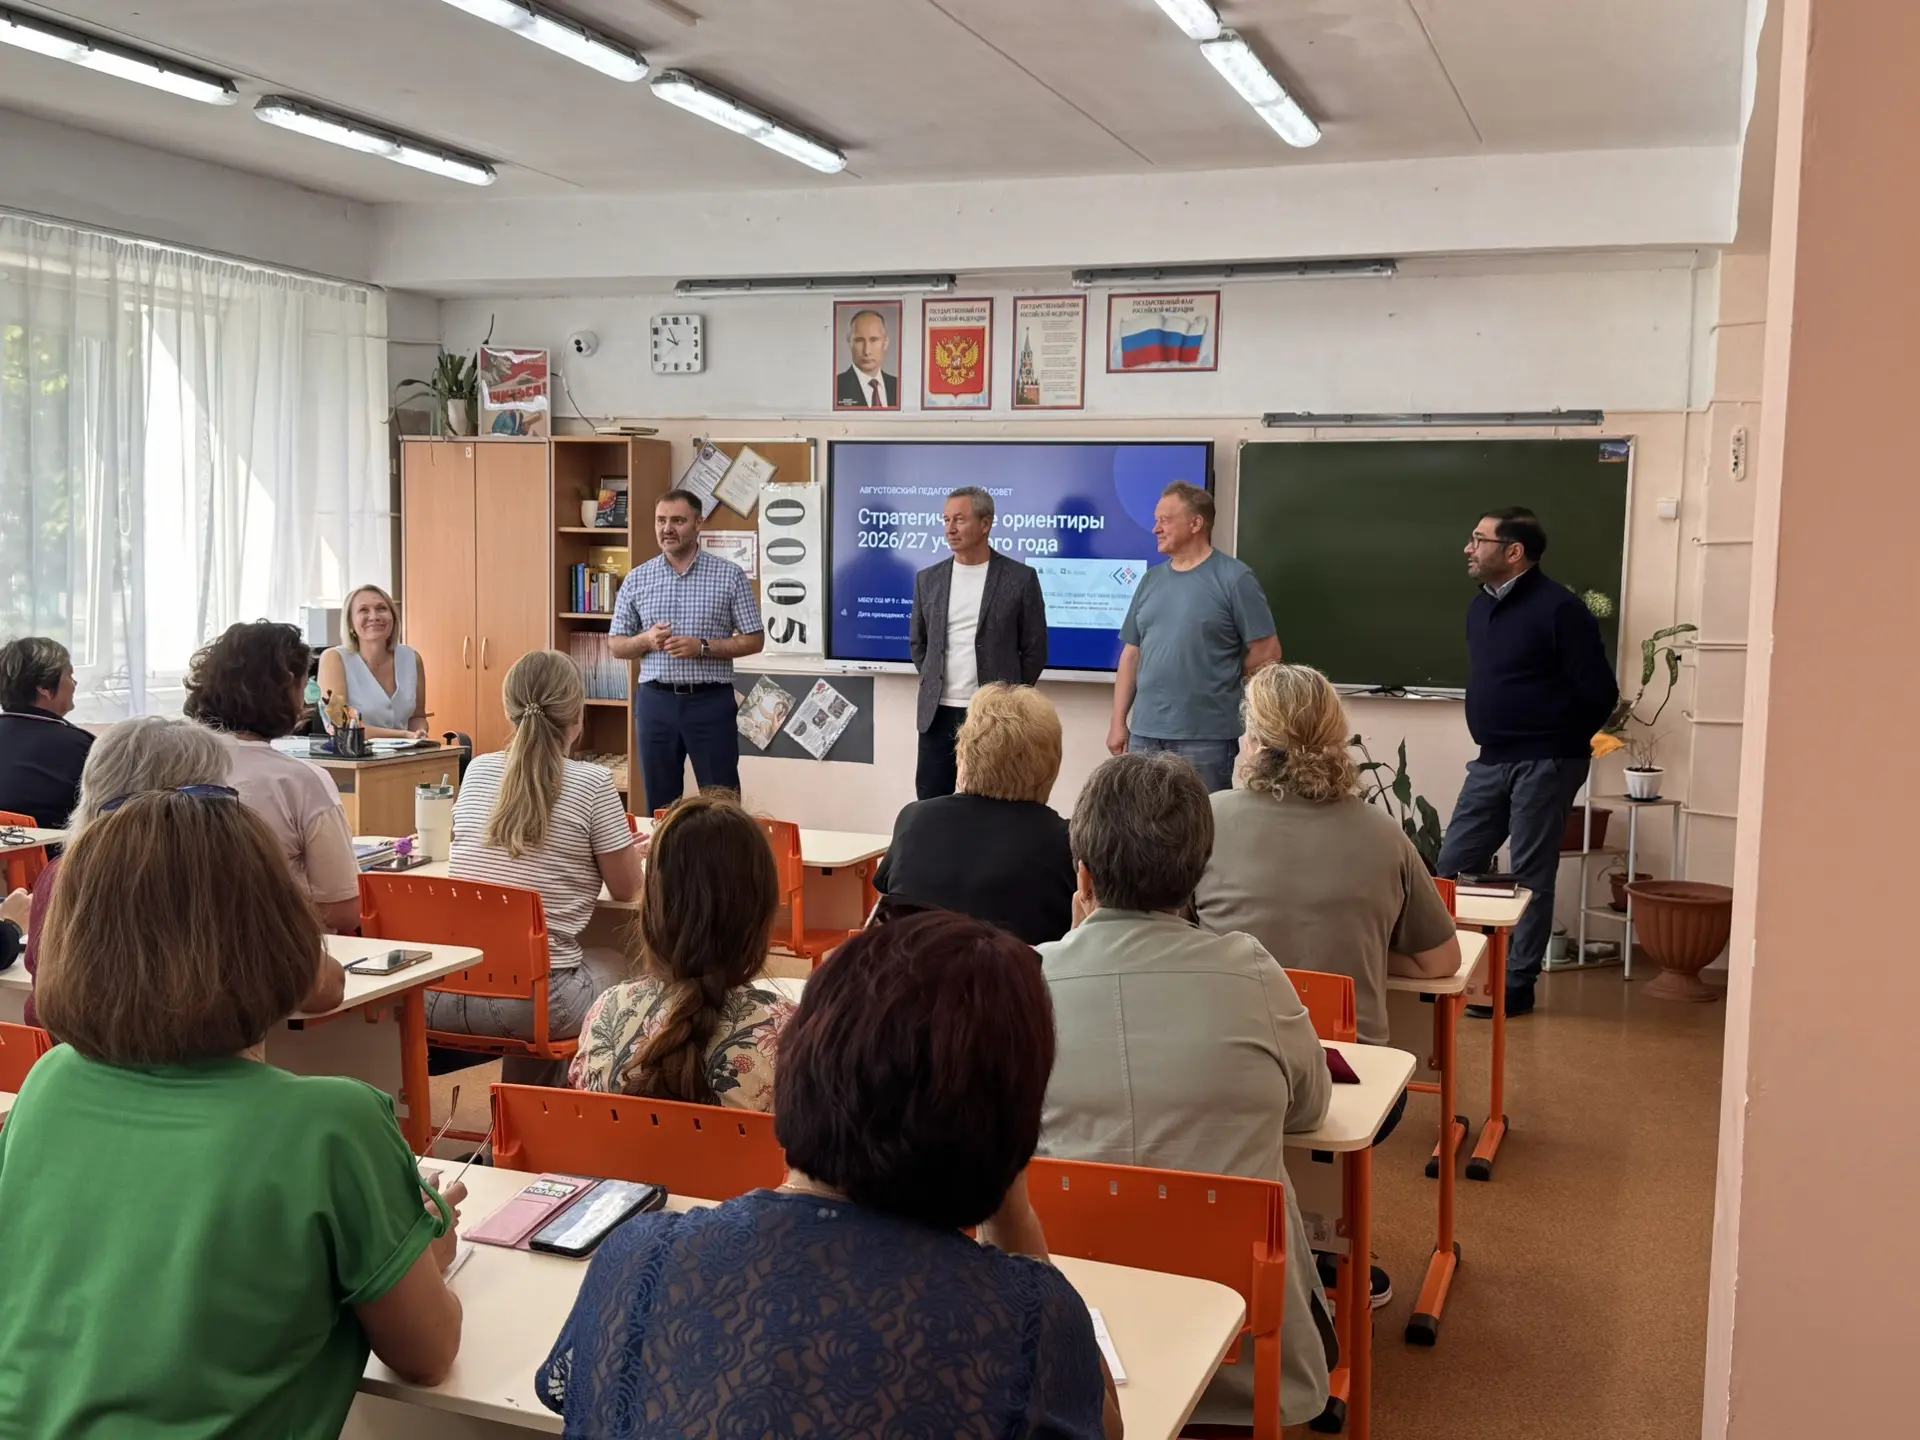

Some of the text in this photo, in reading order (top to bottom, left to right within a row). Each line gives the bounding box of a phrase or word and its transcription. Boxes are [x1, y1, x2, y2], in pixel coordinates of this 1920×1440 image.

[1020, 301, 1066, 310] ГОСУДАРСТВЕННЫЙ
[1132, 297, 1180, 306] ГОСУДАРСТВЕННЫЙ
[928, 306, 974, 314] ГОСУДАРСТВЕННЫЙ
[1132, 306, 1195, 314] РОССИЙСКОЙ ФЕДЕРАЦИИ
[672, 316, 679, 325] 12
[693, 326, 698, 335] 2
[693, 339, 698, 348] 3
[693, 352, 699, 361] 4
[859, 485, 917, 495] АВГУСТОВСКИЙ
[988, 487, 1013, 496] СОВЕТ
[1002, 513, 1105, 533] ориентиры
[857, 531, 928, 549] 2026/27
[1017, 537, 1059, 555] года
